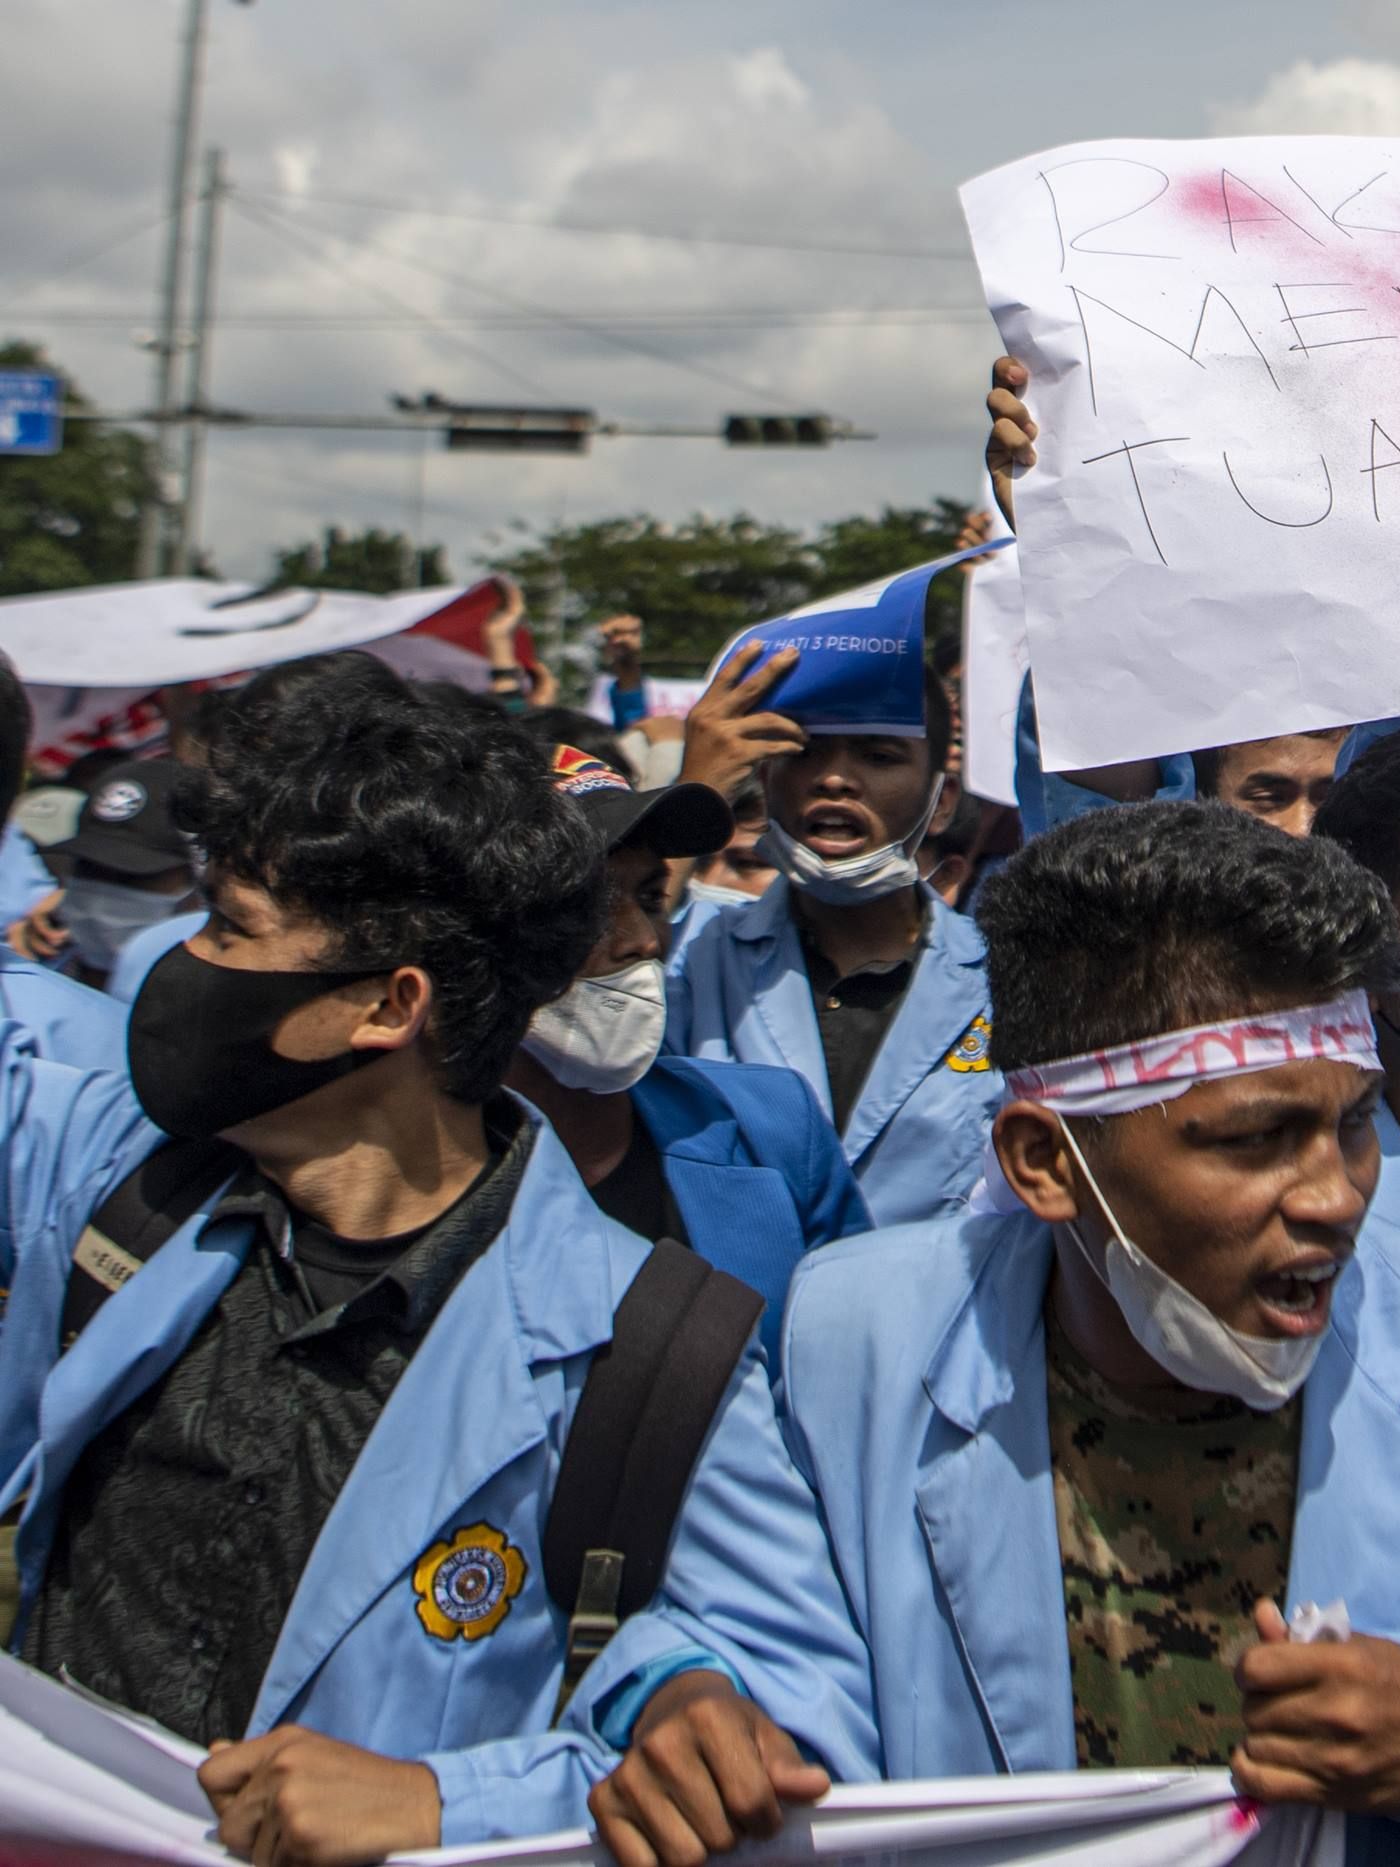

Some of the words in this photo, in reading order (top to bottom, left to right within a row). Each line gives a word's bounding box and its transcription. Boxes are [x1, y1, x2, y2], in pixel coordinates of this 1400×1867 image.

[774, 636, 810, 650] HATI
[812, 636, 824, 650] 3
[826, 635, 909, 655] PERIODE
